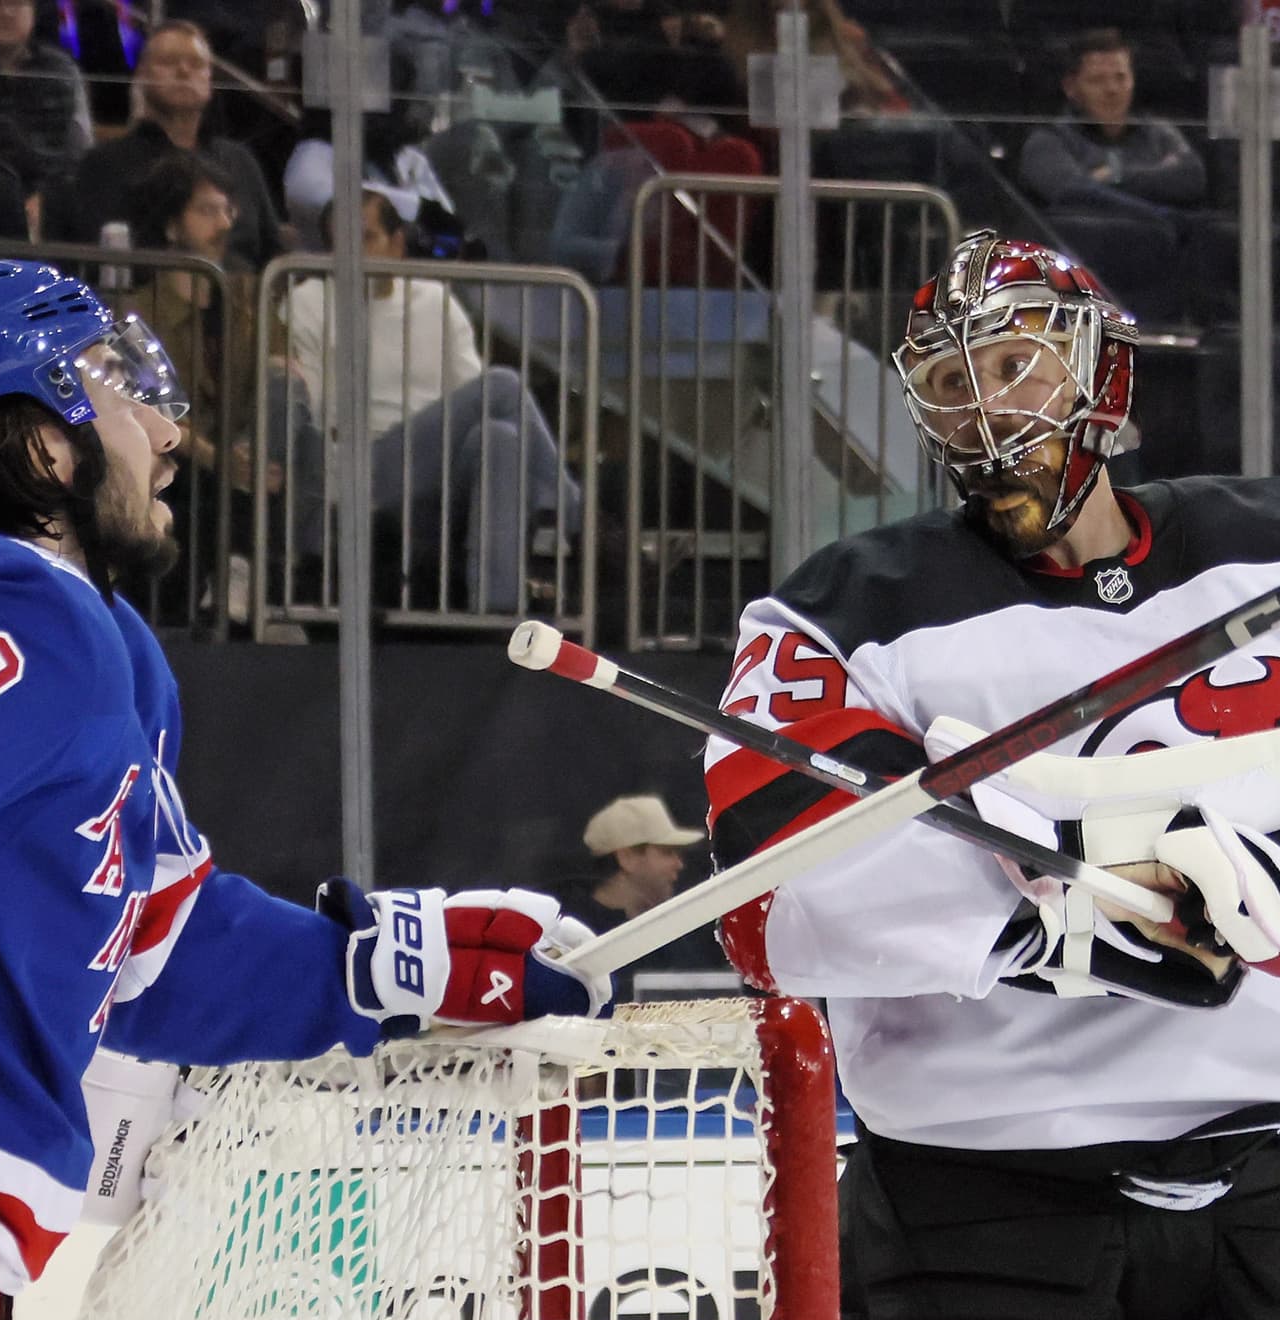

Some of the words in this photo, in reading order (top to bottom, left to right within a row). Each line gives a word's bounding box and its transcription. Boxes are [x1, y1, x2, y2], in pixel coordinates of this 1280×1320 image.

[1106, 577, 1123, 597] NHL
[720, 631, 849, 723] 25
[98, 1118, 133, 1197] BODYARMOR
